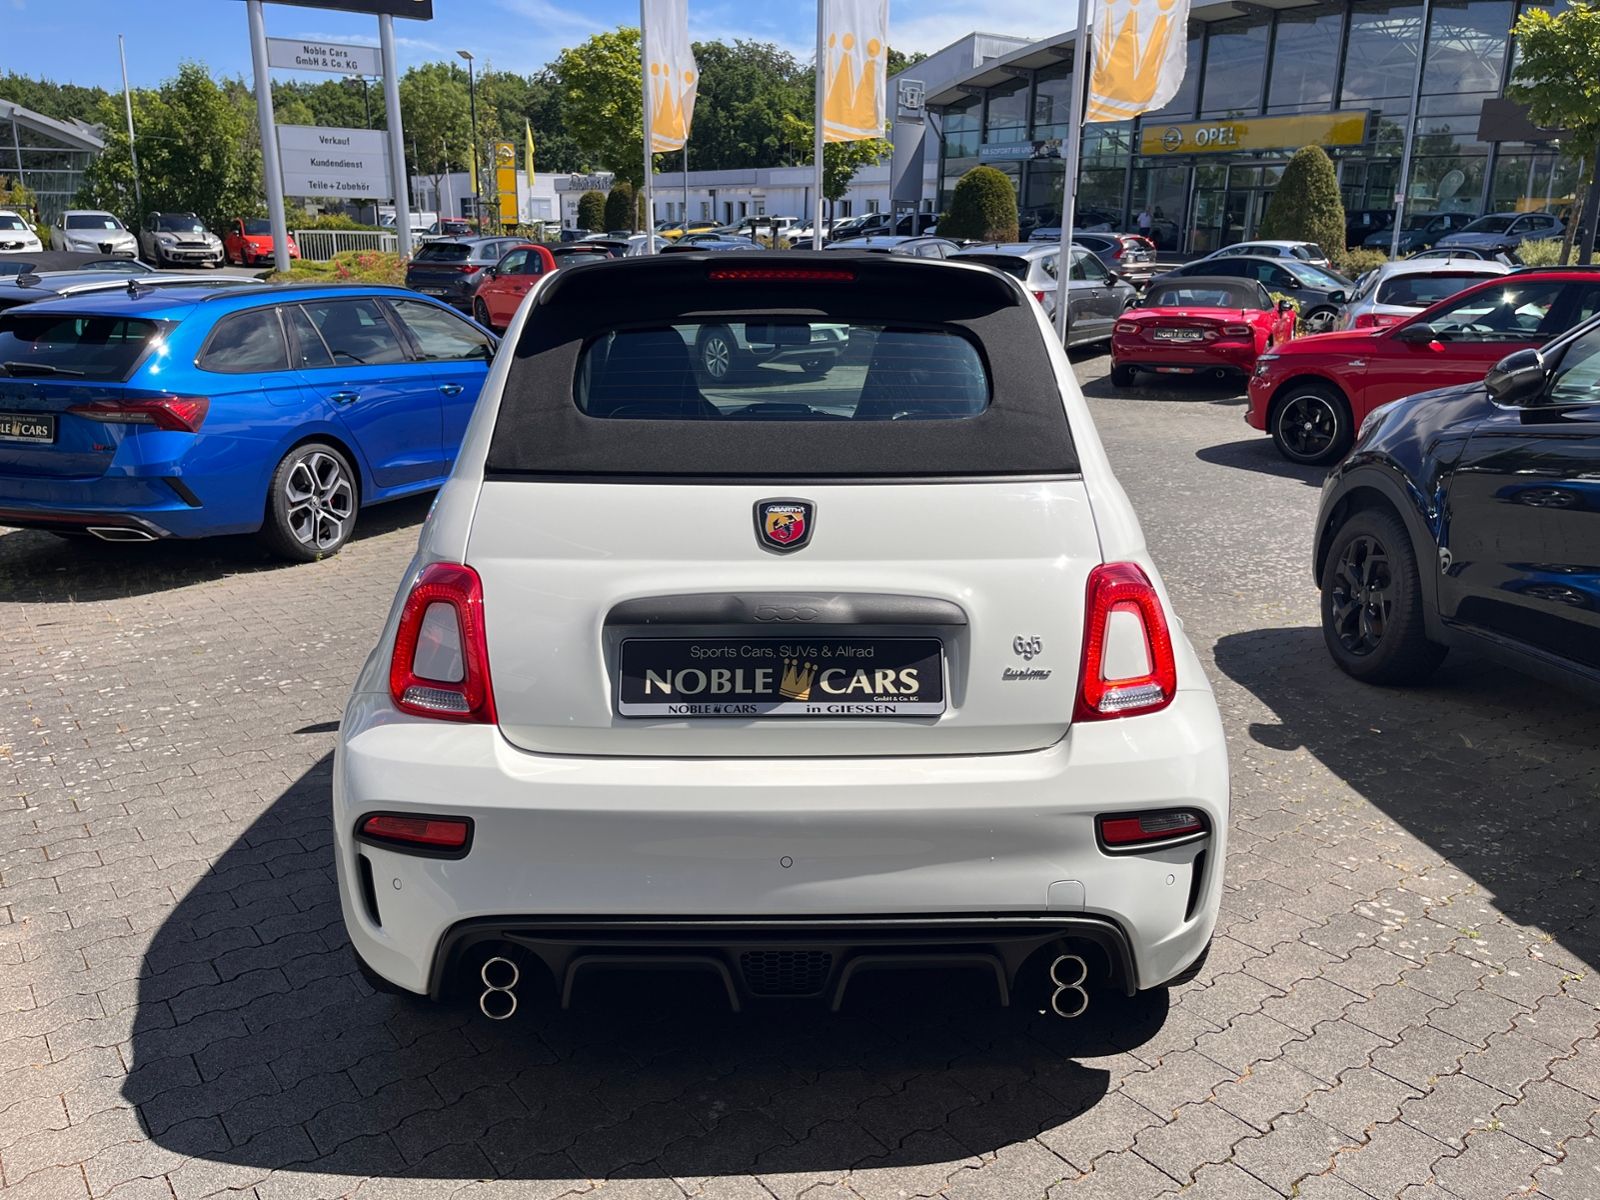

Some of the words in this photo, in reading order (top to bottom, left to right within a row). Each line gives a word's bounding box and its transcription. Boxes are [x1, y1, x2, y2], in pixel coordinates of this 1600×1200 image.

[303, 45, 327, 56] Noble
[329, 48, 348, 58] Cars
[295, 56, 319, 66] GmbH
[321, 58, 328, 67] &
[331, 59, 344, 68] Co.
[346, 60, 358, 70] KG
[318, 135, 350, 146] Verkauf
[1195, 126, 1237, 147] OPEL
[310, 157, 363, 169] Kundendienst
[307, 180, 370, 191] Teile+Zubehör
[0, 423, 11, 434] LE
[21, 424, 48, 436] CARS
[690, 645, 737, 660] Sports
[740, 645, 777, 659] Cars,
[779, 645, 818, 658] SUVs
[821, 645, 833, 658] &
[835, 645, 875, 658] Allrad
[1012, 634, 1044, 662] 695
[644, 668, 774, 695] NOBLE
[819, 667, 920, 695] CARS
[668, 703, 711, 714] NOBLE
[723, 703, 758, 714] CARS
[806, 703, 821, 714] in
[827, 704, 897, 714] GIESSEN
